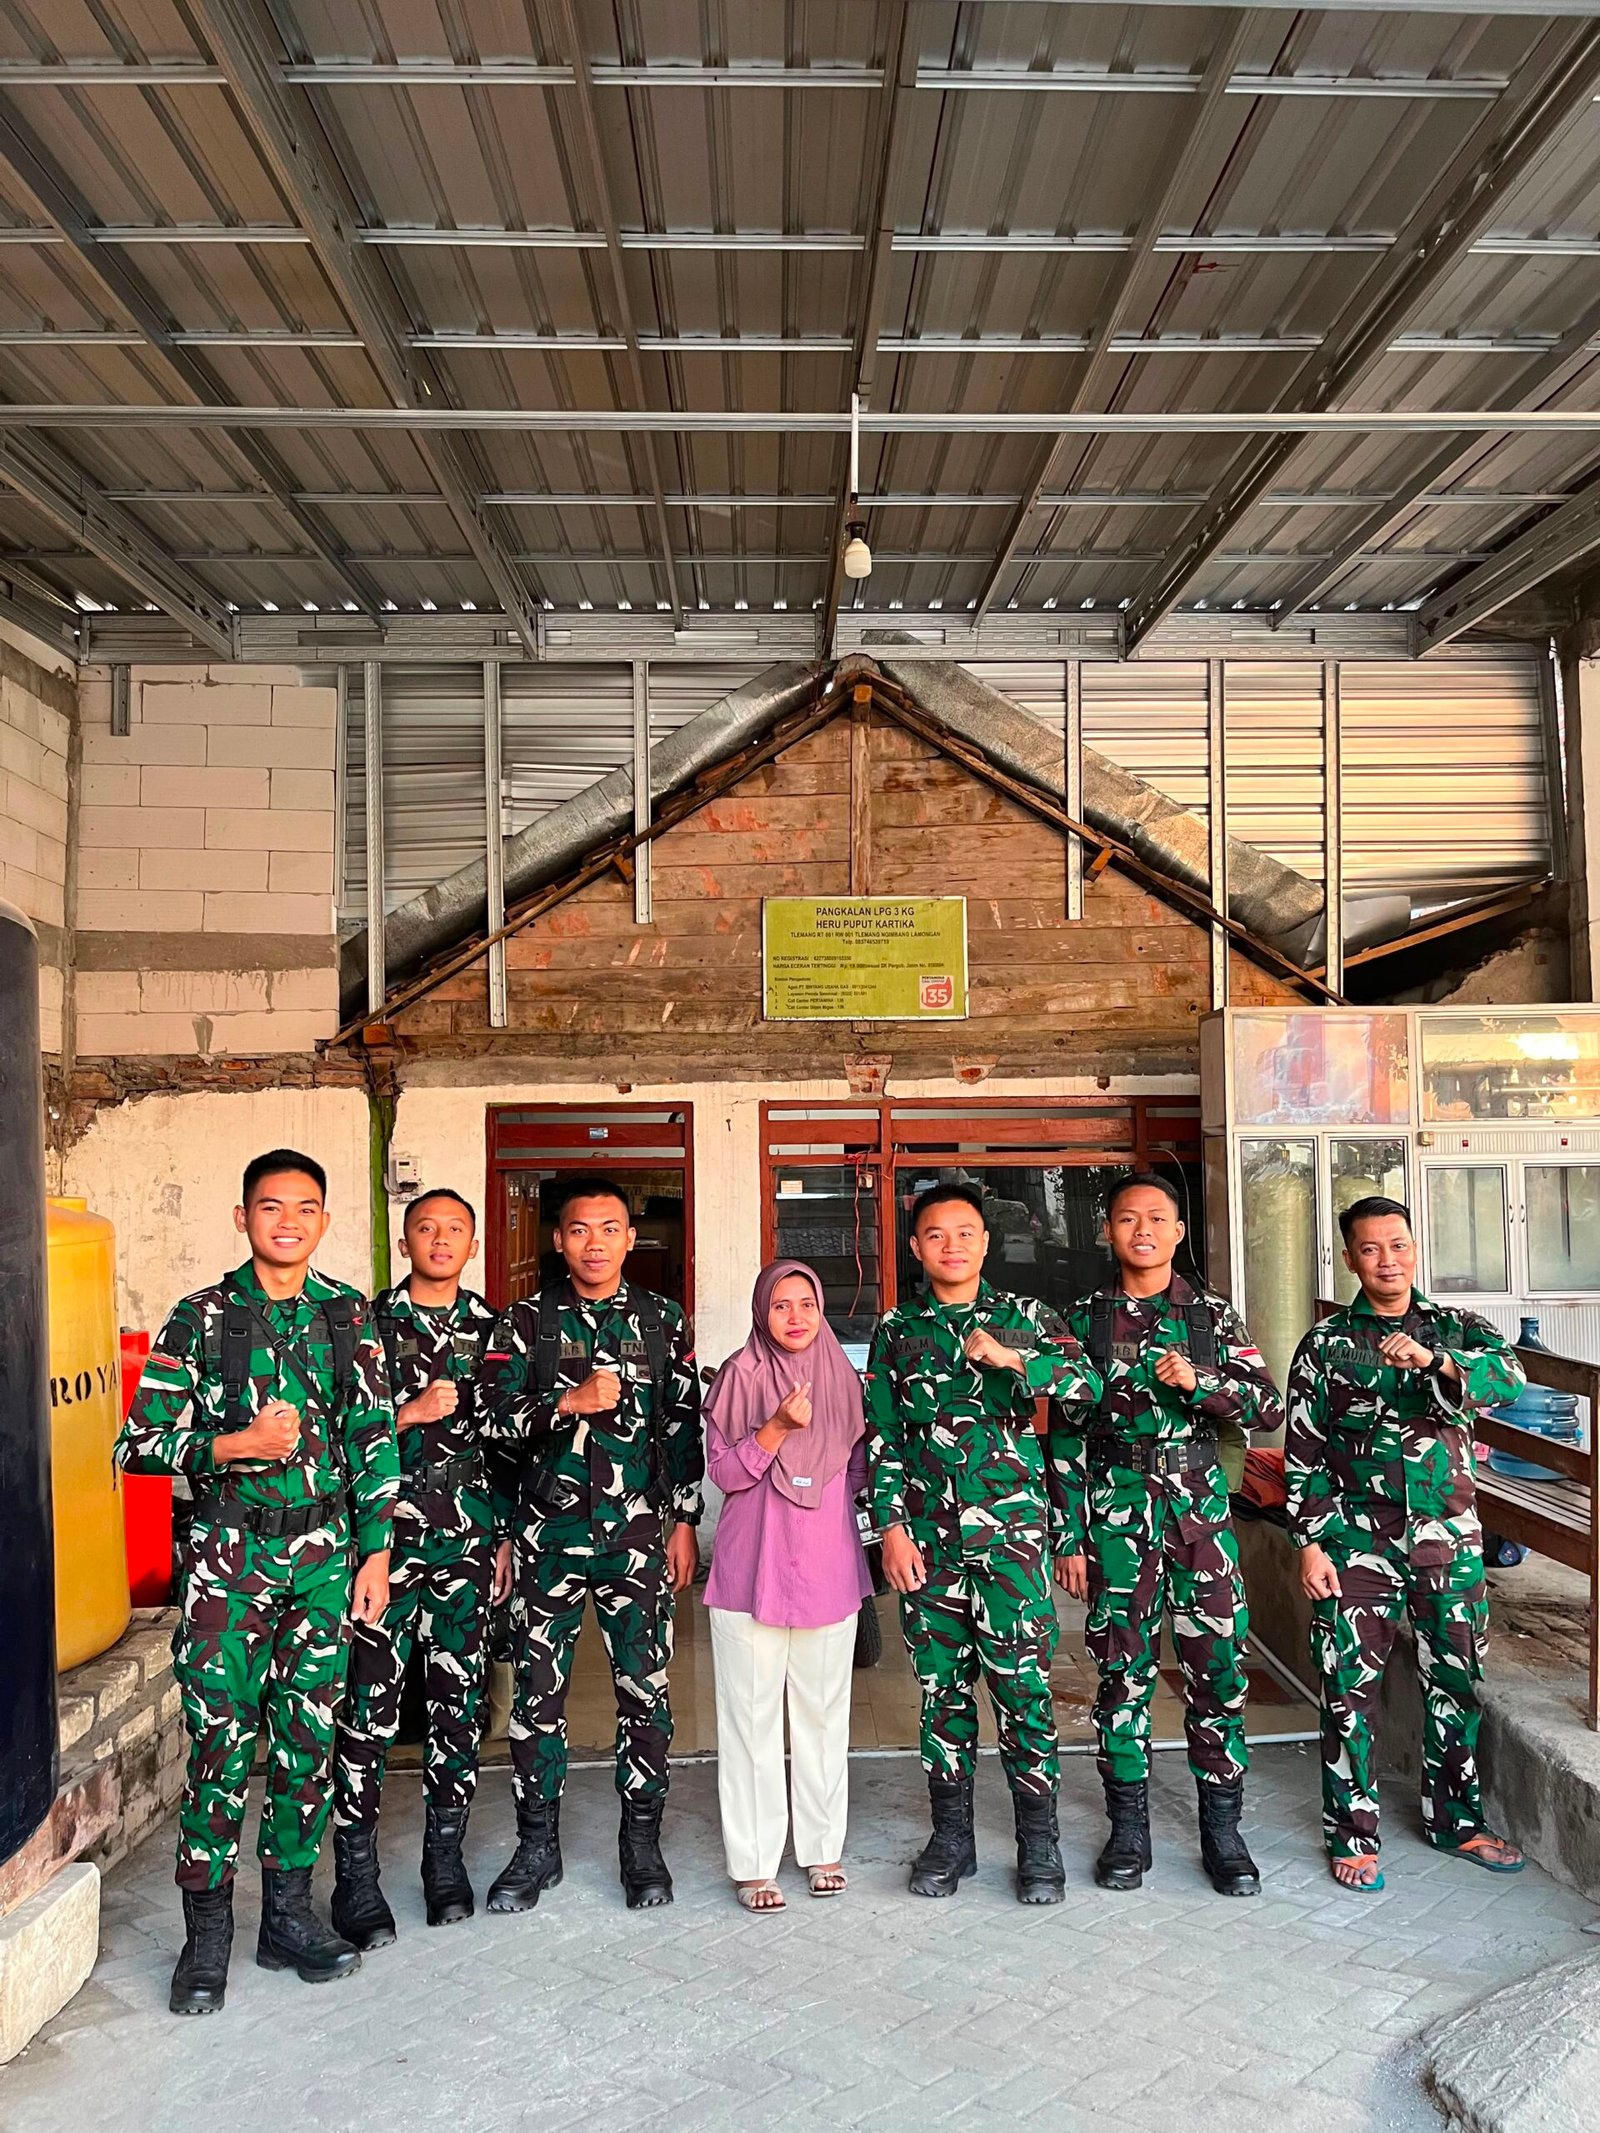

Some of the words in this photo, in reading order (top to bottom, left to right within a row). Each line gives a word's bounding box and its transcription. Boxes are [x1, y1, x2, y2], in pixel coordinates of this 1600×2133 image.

[816, 907, 871, 916] PANGKALAN
[874, 907, 892, 916] LPG
[894, 907, 899, 916] 3
[901, 907, 915, 916] KG
[816, 920, 841, 929] HERU
[843, 920, 873, 929] PUPUT
[875, 920, 915, 929] KARTIKA
[460, 1341, 480, 1353] TNI
[50, 1358, 119, 1407] ROYA
